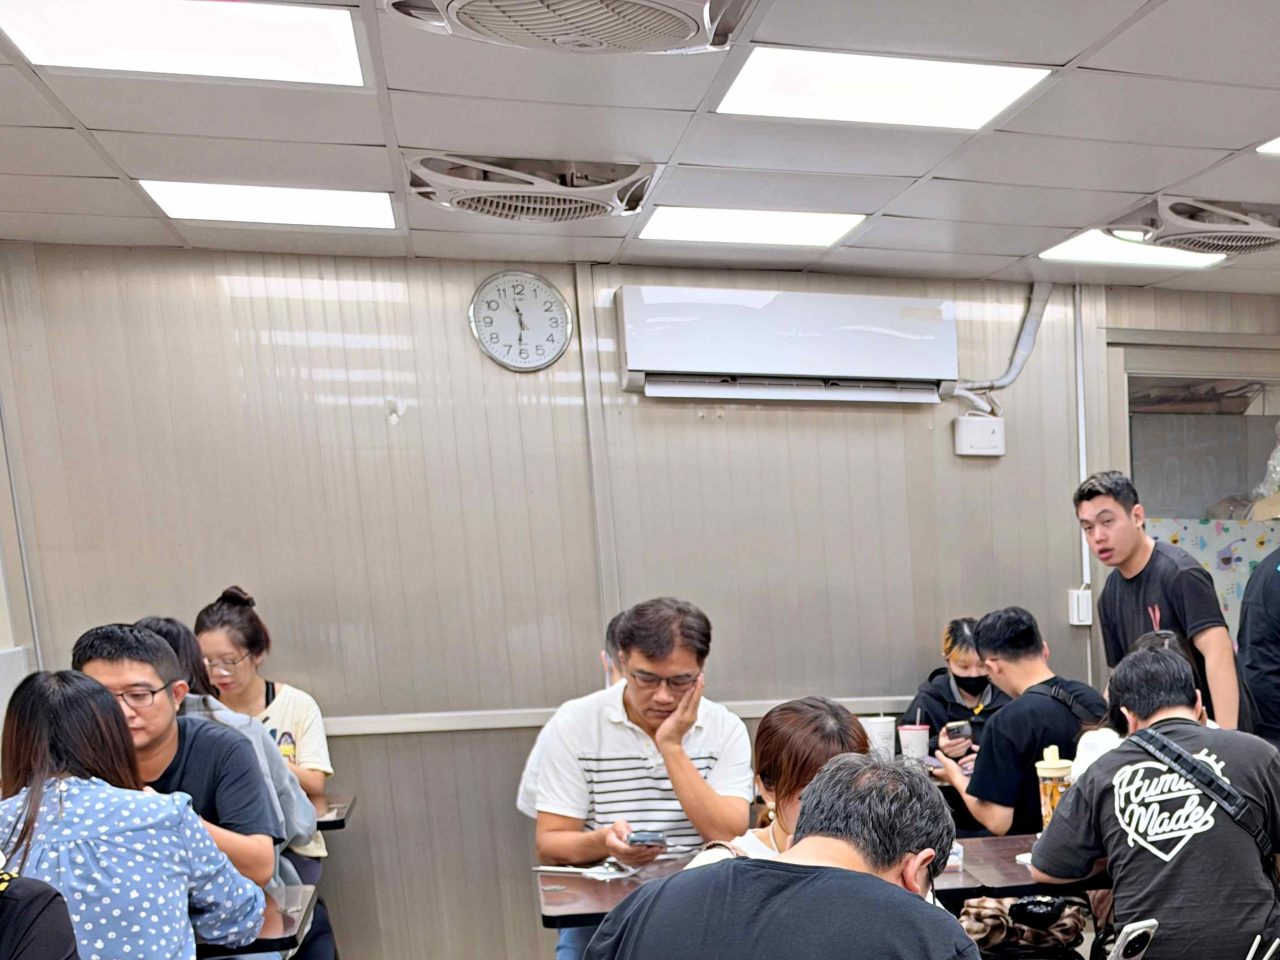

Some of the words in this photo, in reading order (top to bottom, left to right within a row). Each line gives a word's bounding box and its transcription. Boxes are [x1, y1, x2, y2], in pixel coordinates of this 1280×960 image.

[497, 288, 507, 299] 11
[512, 284, 525, 296] 12
[533, 288, 538, 299] 1
[485, 299, 500, 312] 10
[543, 300, 553, 313] 2
[482, 316, 493, 328] 9
[549, 316, 559, 328] 3
[489, 332, 500, 344] 8
[546, 333, 555, 344] 4
[503, 344, 513, 355] 7
[519, 348, 529, 359] 6
[535, 345, 545, 356] 5
[1123, 795, 1207, 838] Made
